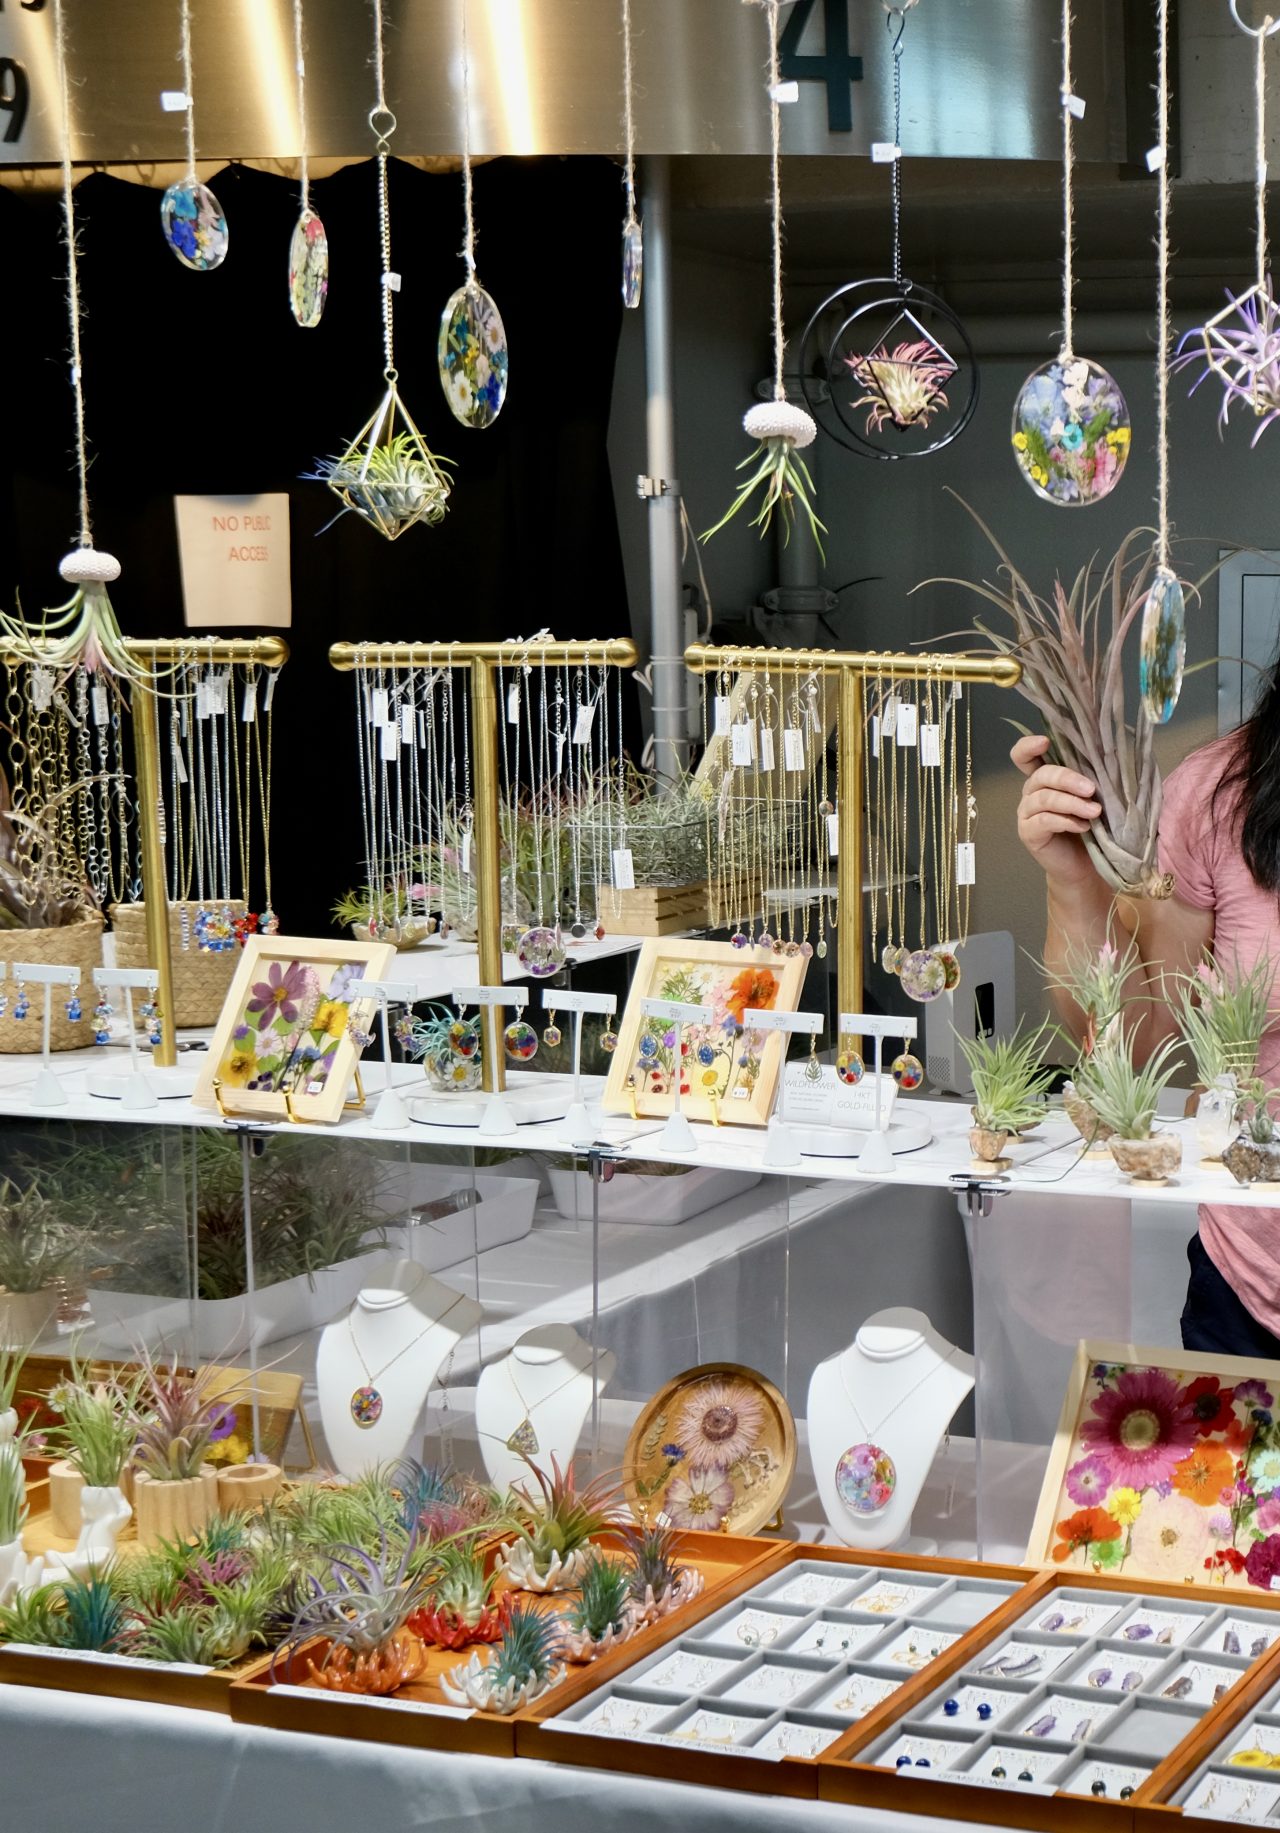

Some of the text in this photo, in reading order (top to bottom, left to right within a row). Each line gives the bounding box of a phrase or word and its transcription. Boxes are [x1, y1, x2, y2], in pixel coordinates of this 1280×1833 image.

[777, 0, 864, 132] 4
[212, 515, 239, 531] NO
[862, 1102, 887, 1112] FILLD
